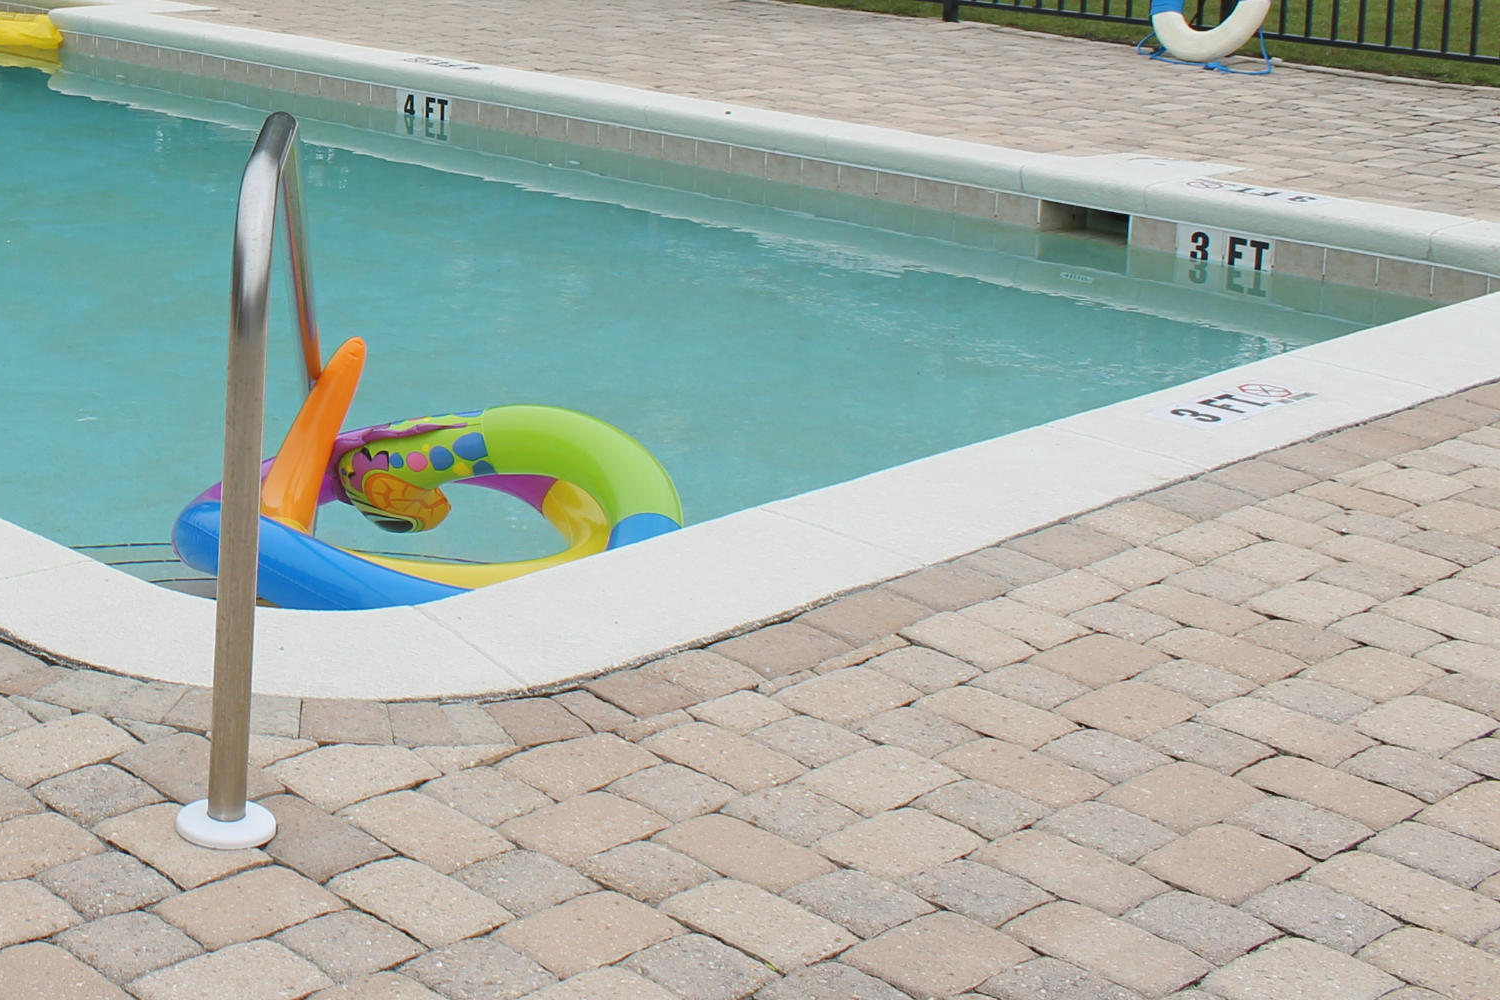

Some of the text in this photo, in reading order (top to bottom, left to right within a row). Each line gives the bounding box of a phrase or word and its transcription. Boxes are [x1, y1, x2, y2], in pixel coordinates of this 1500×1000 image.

[404, 94, 448, 121] 4 FT
[1189, 231, 1270, 271] 3 FT
[1169, 408, 1222, 423] 3
